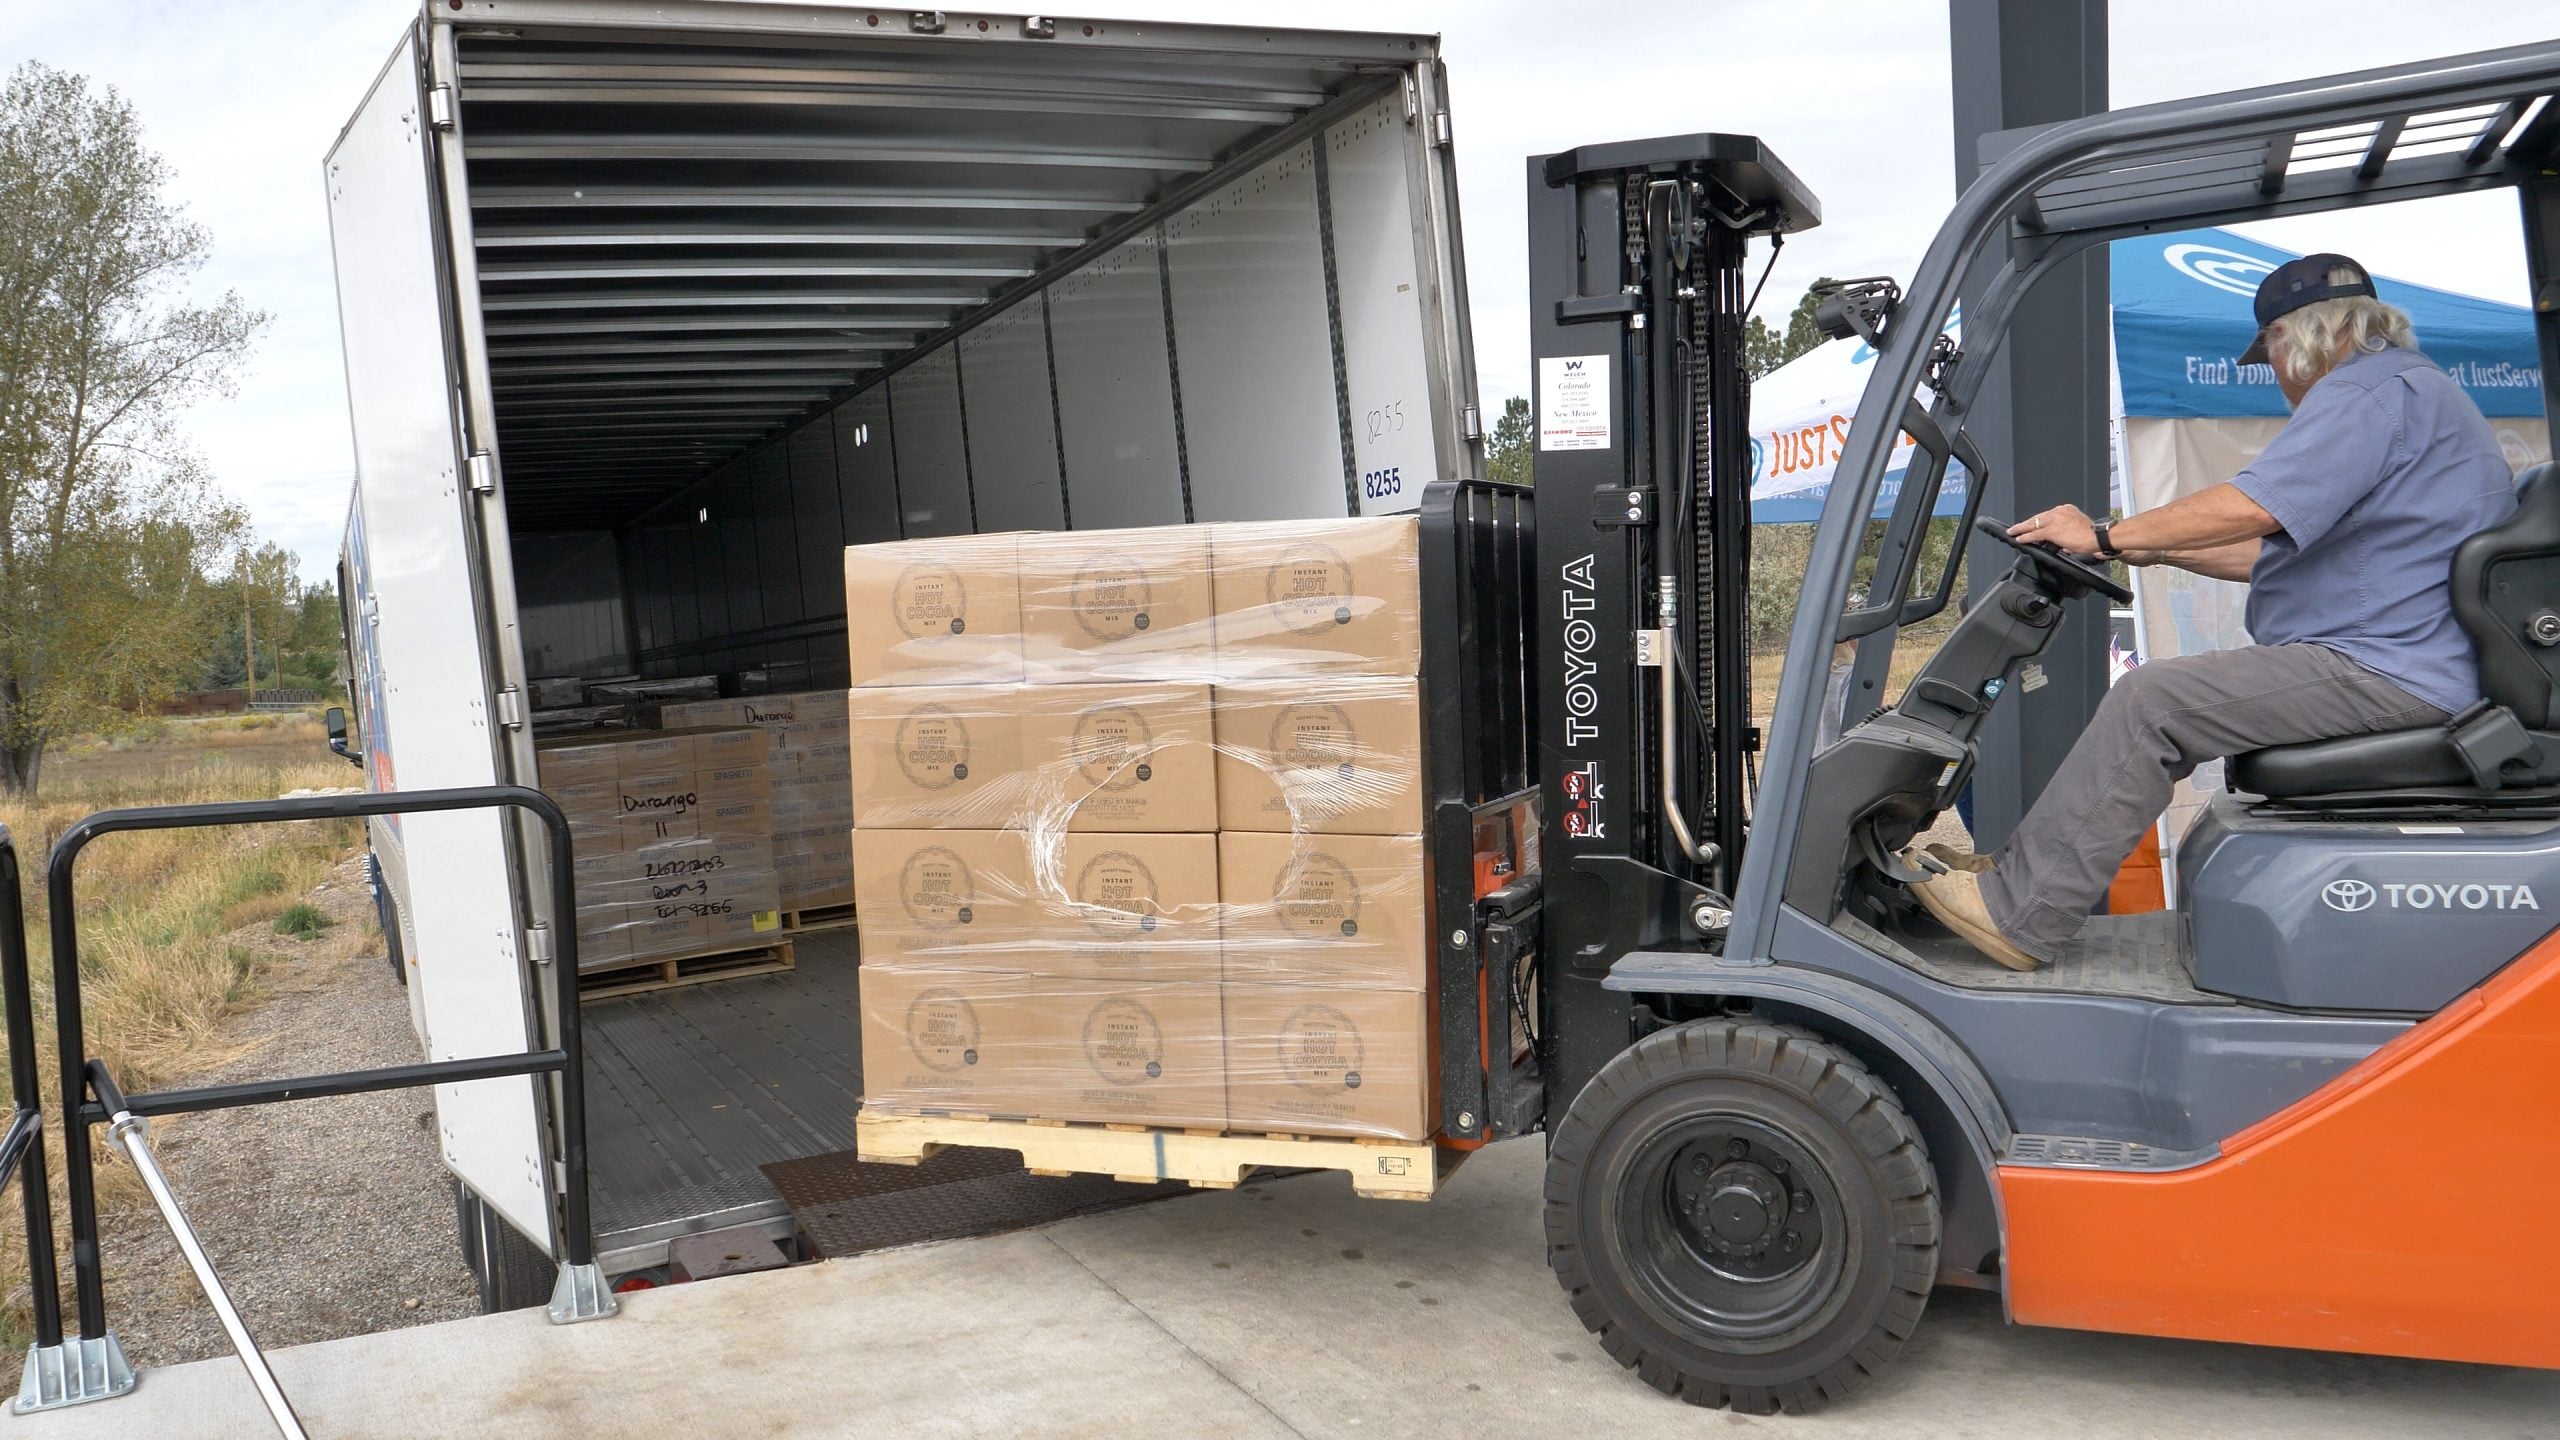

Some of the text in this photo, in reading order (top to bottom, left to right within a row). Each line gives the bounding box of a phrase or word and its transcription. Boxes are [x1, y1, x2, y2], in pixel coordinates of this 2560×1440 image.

[2185, 354, 2228, 385] Find
[2449, 362, 2470, 387] at
[1558, 381, 1591, 391] Colorado
[1554, 409, 1597, 418] New Mexico
[1367, 400, 1404, 444] 8255
[1366, 467, 1401, 499] 8255
[1293, 578, 1326, 591] HOT
[915, 591, 943, 605] HOT
[1095, 586, 1126, 599] HOT
[1282, 593, 1337, 606] COCOA
[907, 605, 954, 619] COCOA
[1085, 600, 1137, 614] COCOA
[1562, 553, 1599, 747] TOYOTA
[744, 704, 793, 728] Durango
[711, 733, 751, 745] SPAGHETTI
[918, 736, 946, 749] HOT
[909, 750, 956, 763] COCOA
[1087, 752, 1139, 764] COCOA
[1286, 749, 1341, 762] COCOA
[713, 769, 753, 781] SPAGHETTI
[622, 792, 697, 815] Durango
[716, 805, 755, 818] SPAGHETTI
[715, 840, 755, 853] SPAGHETTI
[923, 880, 950, 892] HOT
[1102, 886, 1132, 898] HOT
[913, 893, 961, 906] COCOA
[1300, 888, 1333, 901] HOT
[2382, 883, 2540, 910] TOYOTA
[1290, 904, 1344, 918] COCOA
[649, 919, 689, 934] SPAGHETTI
[928, 1020, 955, 1032] HOT
[920, 1033, 966, 1046] COCOA
[1107, 1032, 1137, 1044] HOT
[1098, 1045, 1149, 1059] COCOA
[1304, 1040, 1336, 1053] HOT
[1294, 1056, 1348, 1068] COCOA
